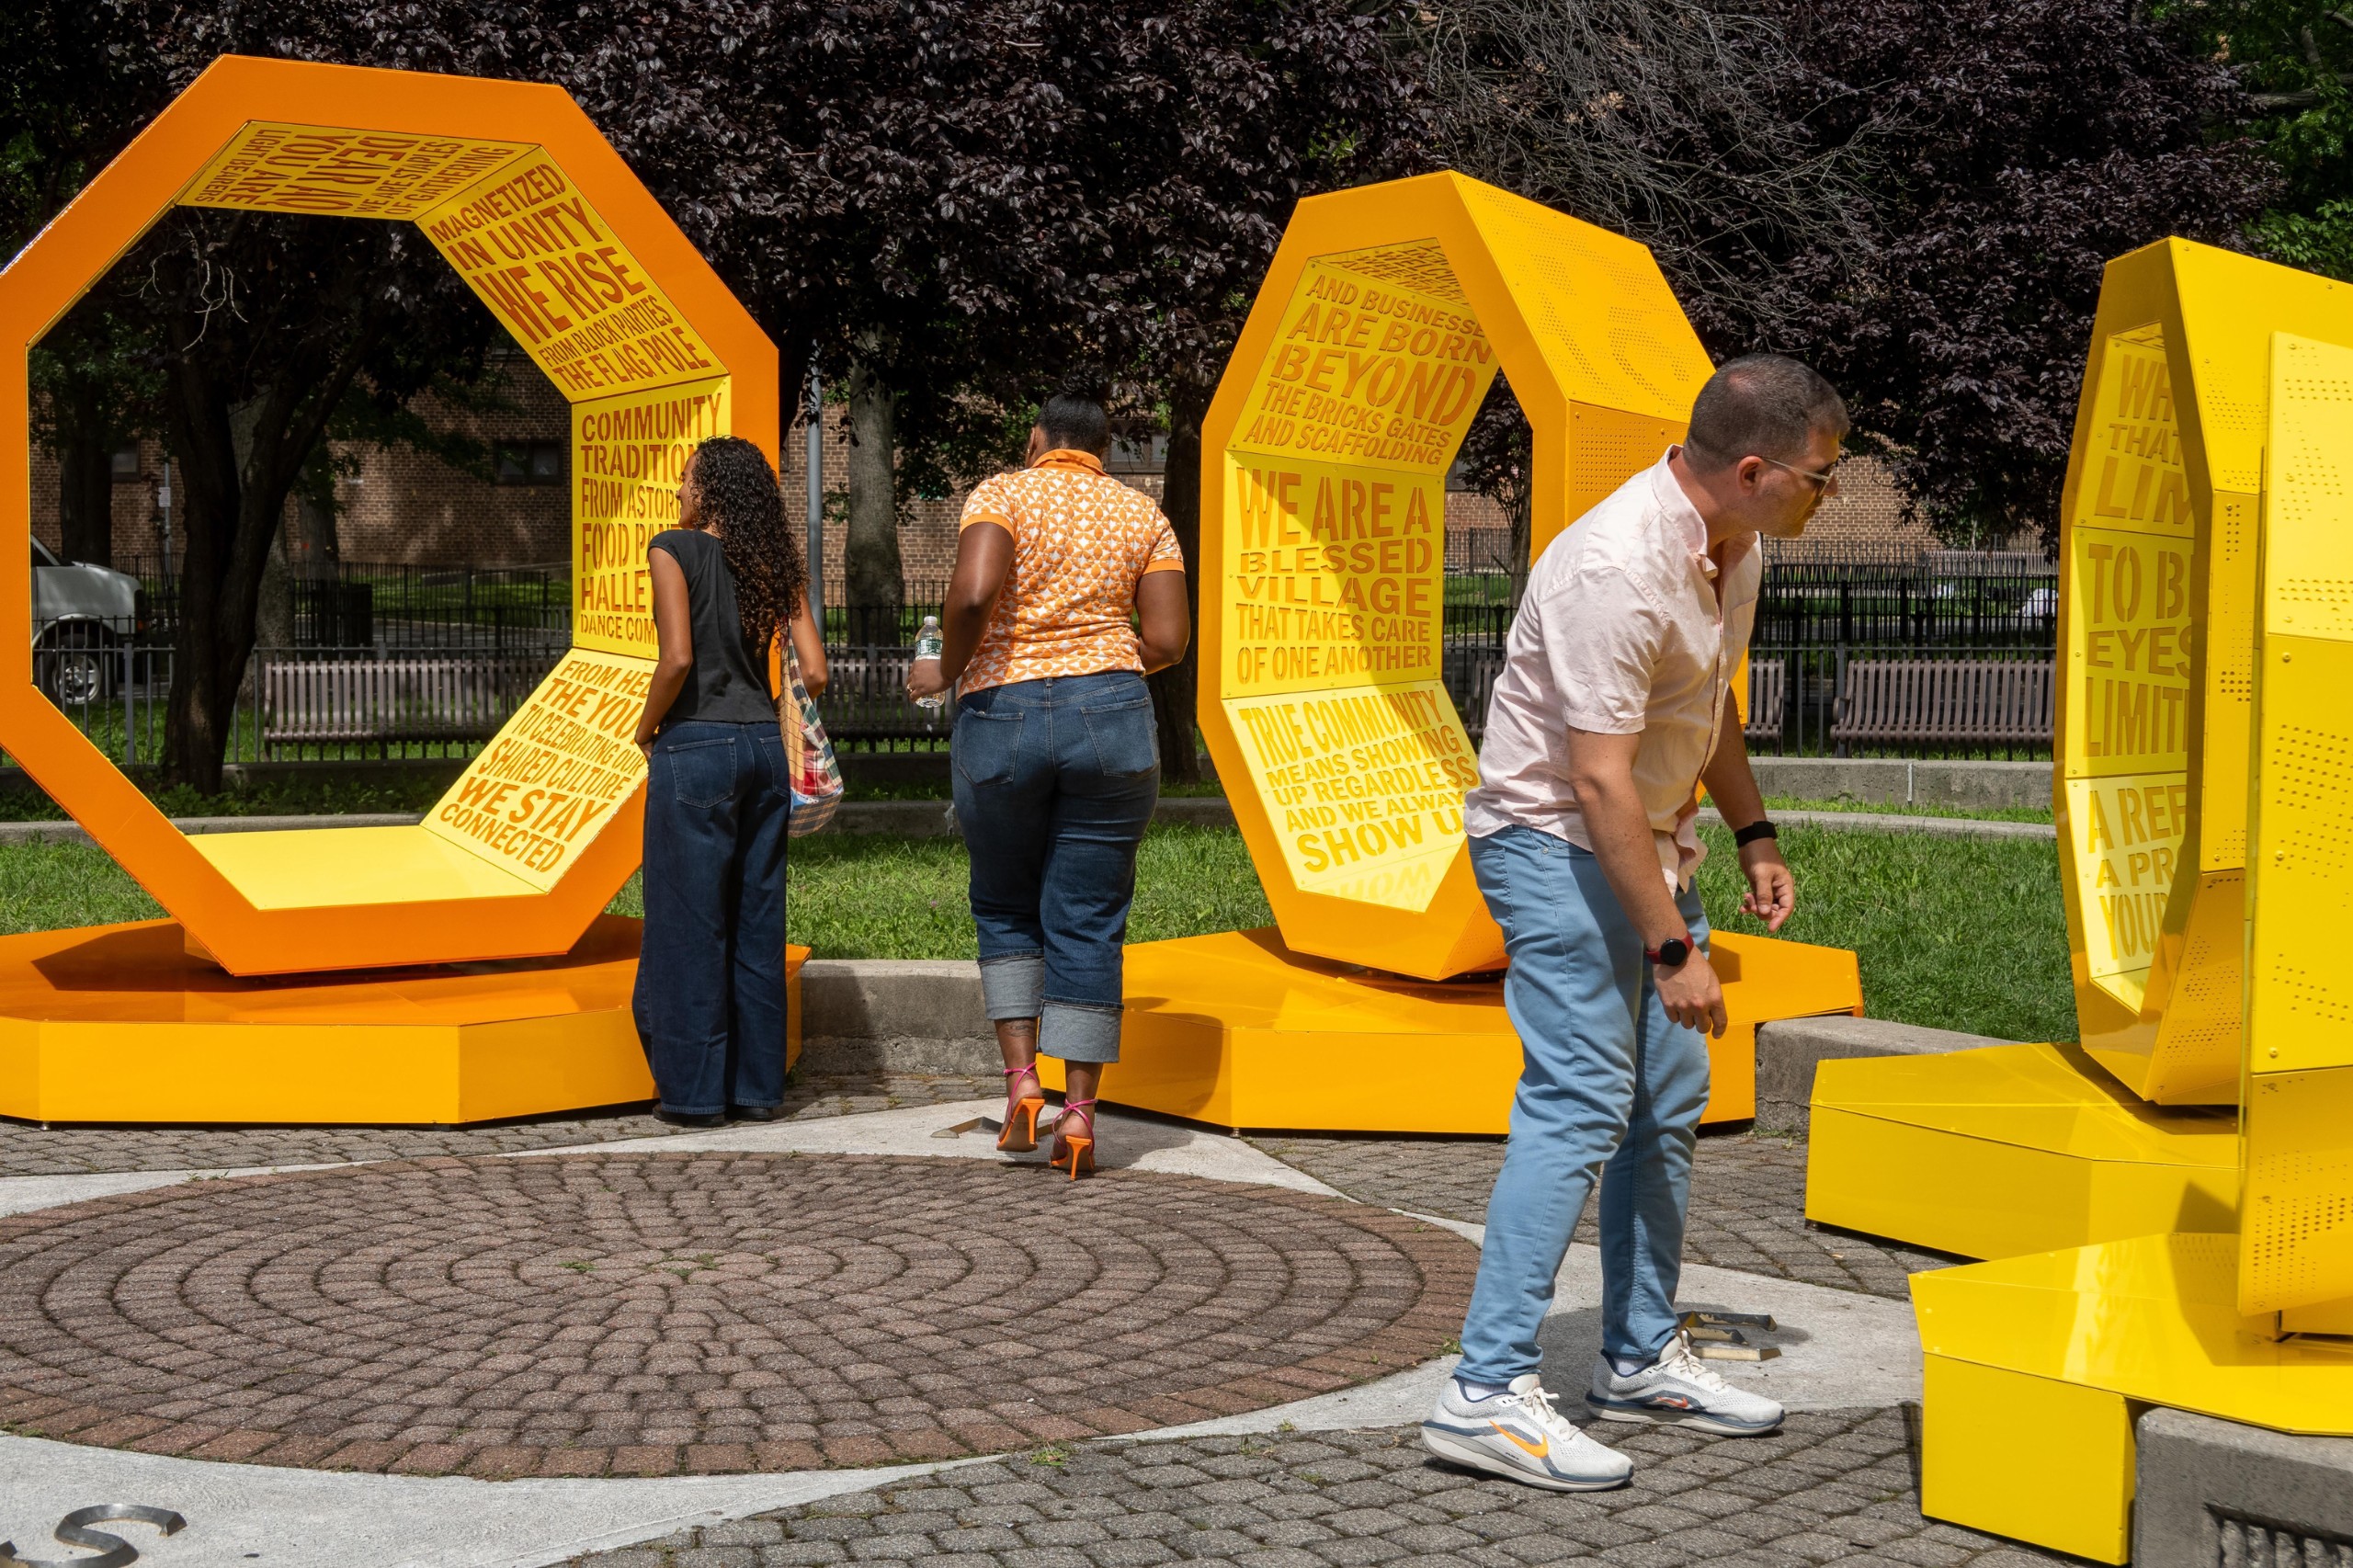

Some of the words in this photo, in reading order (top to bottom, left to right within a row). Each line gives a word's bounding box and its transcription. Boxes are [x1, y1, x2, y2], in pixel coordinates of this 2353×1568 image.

[236, 129, 293, 158] LIGHT
[265, 134, 359, 167] YOU
[295, 135, 420, 185] DEAR
[391, 142, 464, 180] STAPLES
[194, 158, 258, 202] BEARERS
[217, 169, 292, 205] ARE
[371, 179, 414, 199] ARE
[384, 201, 418, 215] OF
[404, 146, 517, 201] GATHERING
[428, 164, 566, 244] MAGNETIZED
[353, 199, 390, 212] WE
[447, 236, 496, 271] IN
[486, 197, 603, 260] UNITY
[472, 265, 574, 345] WE
[535, 246, 647, 321] RISE
[1306, 274, 1358, 305] AND
[538, 337, 582, 367] FROM
[571, 317, 623, 354] BLOCK
[608, 294, 674, 339] PARTIES
[1287, 302, 1379, 348] ARE
[1379, 322, 1494, 365] BORN
[551, 358, 605, 392] THE
[588, 343, 657, 385] FLAG
[637, 326, 711, 375] POLE
[1270, 344, 1476, 426] BEYOND
[582, 392, 722, 442] COMMUNITY
[1243, 415, 1295, 447] AND
[1295, 423, 1443, 465] SCAFFOLDING
[1260, 381, 1306, 416] THE
[1302, 392, 1385, 434] BRICKS
[1386, 416, 1452, 449] GATES
[581, 477, 623, 518] FROM
[1236, 467, 1302, 550] WE
[1310, 476, 1394, 543] ARE
[1403, 486, 1432, 535] A
[582, 522, 630, 572] FOOD
[635, 523, 679, 566] PA
[1240, 538, 1433, 574] BLESSED
[581, 568, 654, 613] HALLE
[1236, 575, 1432, 619] VILLAGE
[2087, 543, 2142, 624] TO
[2155, 551, 2194, 620] B
[581, 613, 623, 640] DANCE
[626, 617, 659, 646] COM
[1235, 603, 1291, 641] THAT
[1295, 608, 1365, 642] TAKES
[1371, 617, 1431, 642] CARE
[560, 660, 618, 687] FROM
[1236, 646, 1267, 685] OF
[1272, 645, 1320, 681] ONE
[1324, 645, 1431, 676] ANOTHER
[540, 677, 599, 718] THE
[585, 692, 642, 745] YOU
[1238, 703, 1314, 768] TRUE
[1302, 689, 1443, 753] COMMUNITY
[512, 703, 544, 736] TO
[529, 711, 620, 766] CELEBRATING
[612, 748, 647, 777] OUR
[1266, 754, 1349, 789] MEANS
[1351, 724, 1462, 772] SHOWING
[478, 737, 559, 784] SHARED
[546, 758, 631, 801] CULTURE
[1272, 785, 1308, 807] UP
[1313, 756, 1479, 803] REGARDLESS
[457, 777, 520, 815] WE
[508, 789, 609, 843] STAY
[1285, 806, 1337, 833] AND
[1338, 801, 1386, 824] WE
[1387, 790, 1467, 816] ALWAY
[2088, 790, 2115, 854] A
[439, 802, 565, 873] CONNECTED
[1296, 814, 1424, 873] SHOW
[1431, 806, 1467, 835] U
[2096, 858, 2121, 889] A
[2128, 846, 2182, 887] PR
